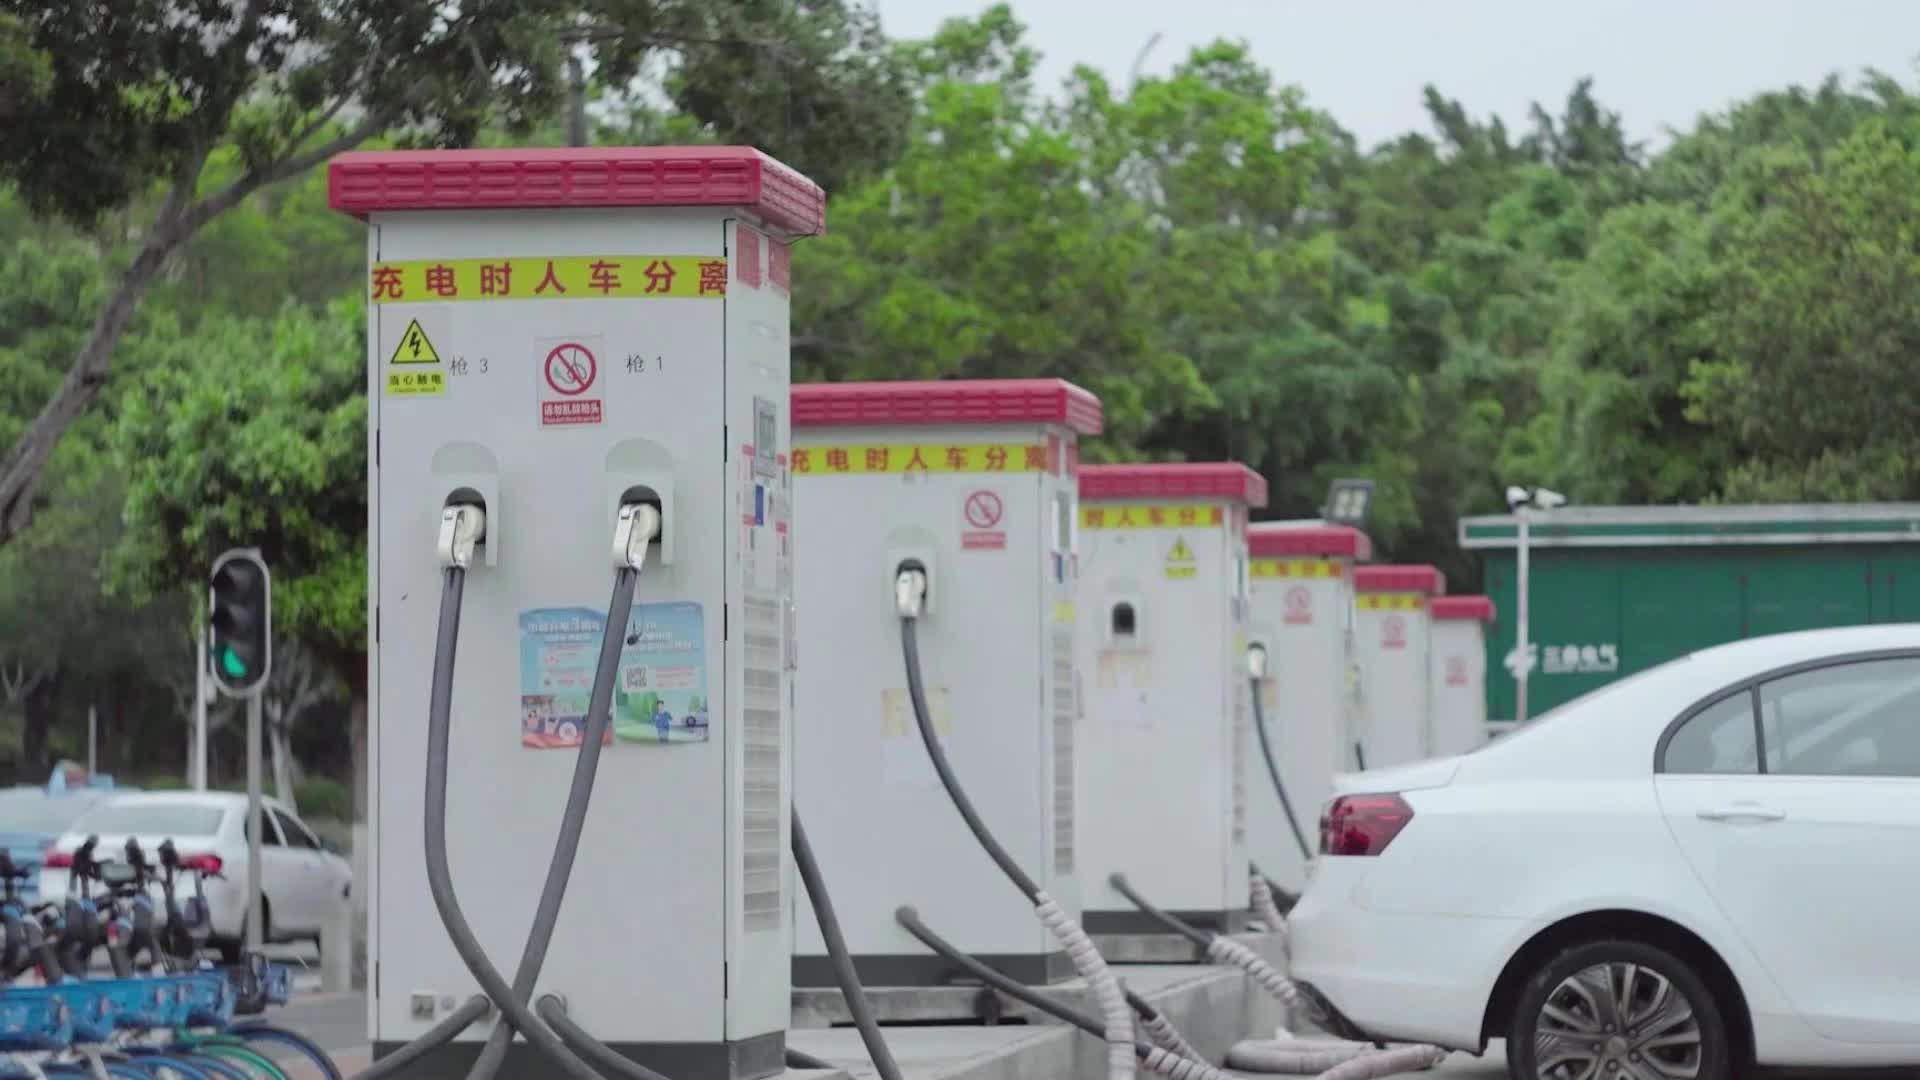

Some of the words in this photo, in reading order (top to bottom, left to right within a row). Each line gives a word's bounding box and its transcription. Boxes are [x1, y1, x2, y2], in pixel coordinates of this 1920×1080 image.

[372, 260, 728, 300] 充电时人车分离
[449, 354, 468, 376] 枪
[479, 358, 488, 373] 3
[626, 355, 645, 374] 枪
[656, 356, 662, 371] 1
